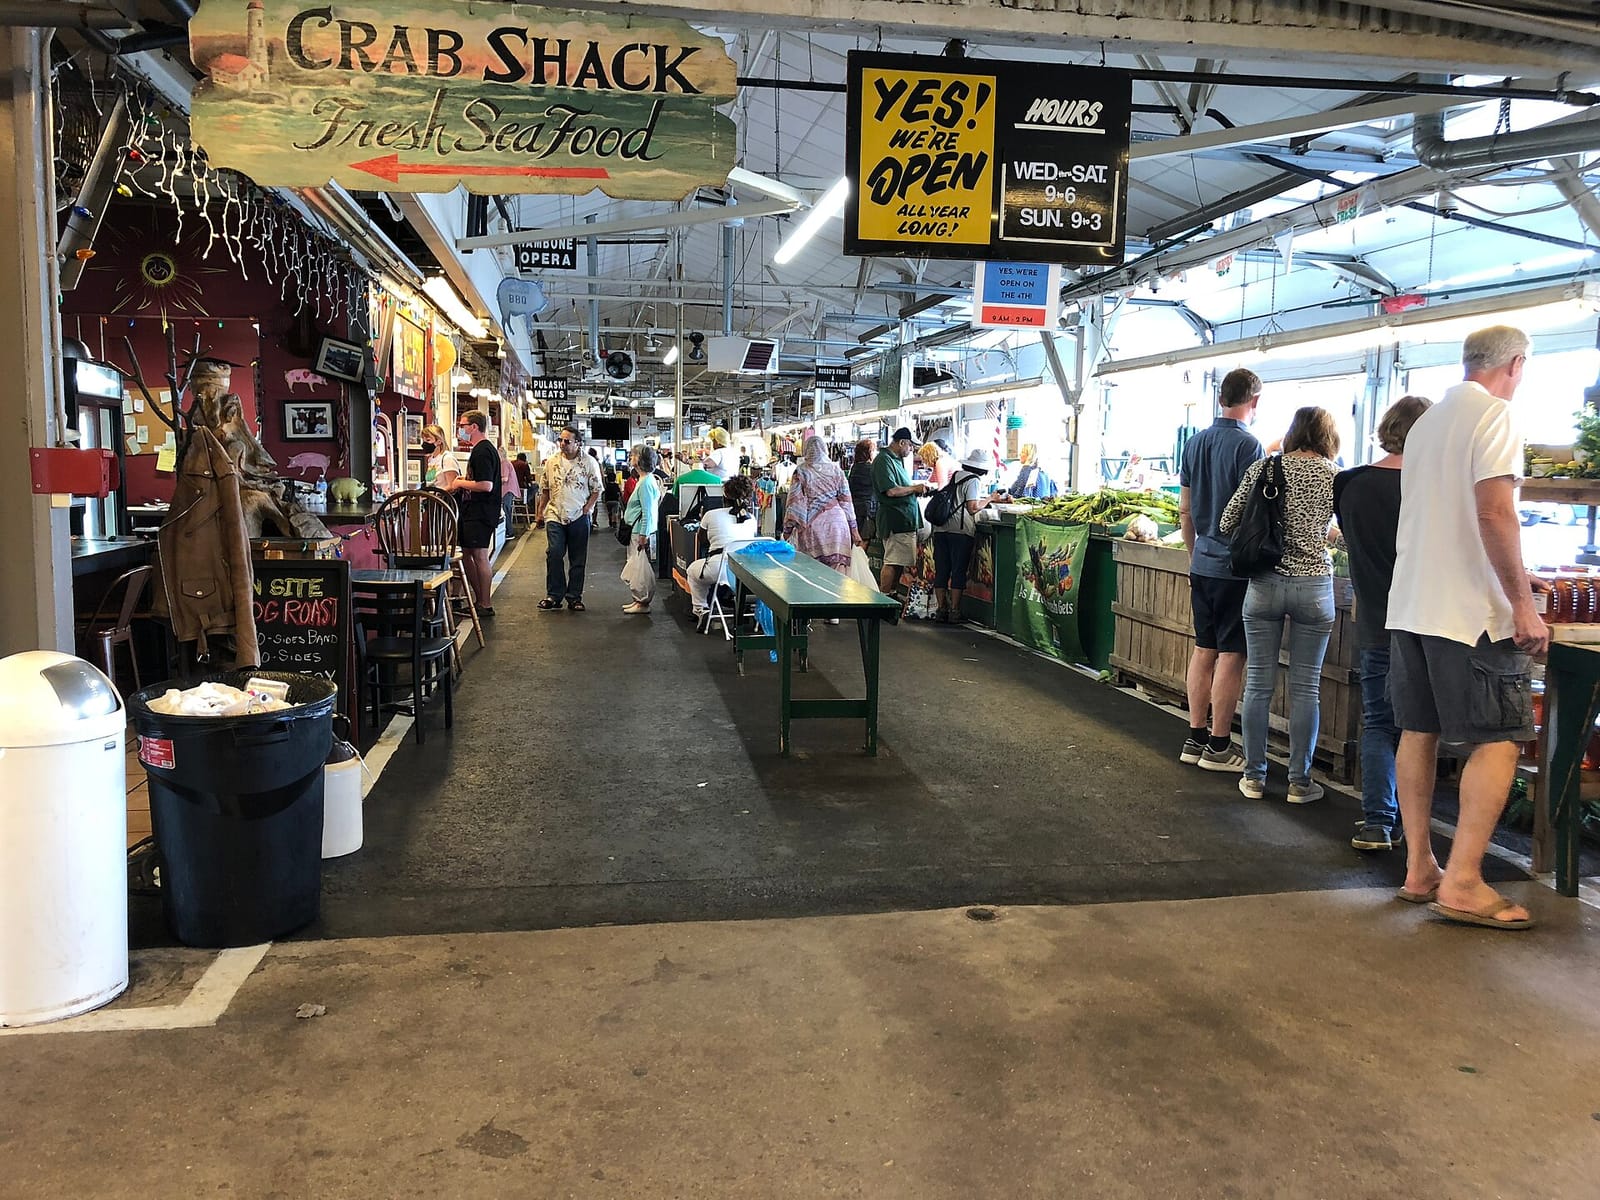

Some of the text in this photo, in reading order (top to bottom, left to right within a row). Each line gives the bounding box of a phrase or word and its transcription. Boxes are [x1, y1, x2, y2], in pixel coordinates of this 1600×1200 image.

[286, 5, 703, 94] CRAB SHACK
[873, 77, 992, 130] YES!
[1024, 97, 1104, 126] HOURS
[292, 87, 452, 156] Fresh
[888, 125, 960, 151] WE'RE
[866, 150, 989, 206] OPEN
[1013, 160, 1059, 181] WED.
[1071, 164, 1108, 184] SAT.
[1044, 184, 1057, 203] 9
[1064, 186, 1077, 205] 6
[896, 203, 971, 219] ALL YEAR
[1019, 207, 1064, 228] SUN.
[1070, 211, 1083, 229] 9
[1089, 213, 1102, 231] 3
[897, 220, 960, 237] LONG!
[520, 251, 571, 266] OPERA
[1000, 279, 1020, 287] OPEN
[1001, 291, 1015, 299] THE
[533, 380, 566, 389] PULASKI
[534, 390, 565, 398] MEATS
[269, 577, 324, 598] SITE
[284, 597, 338, 626] ROAST
